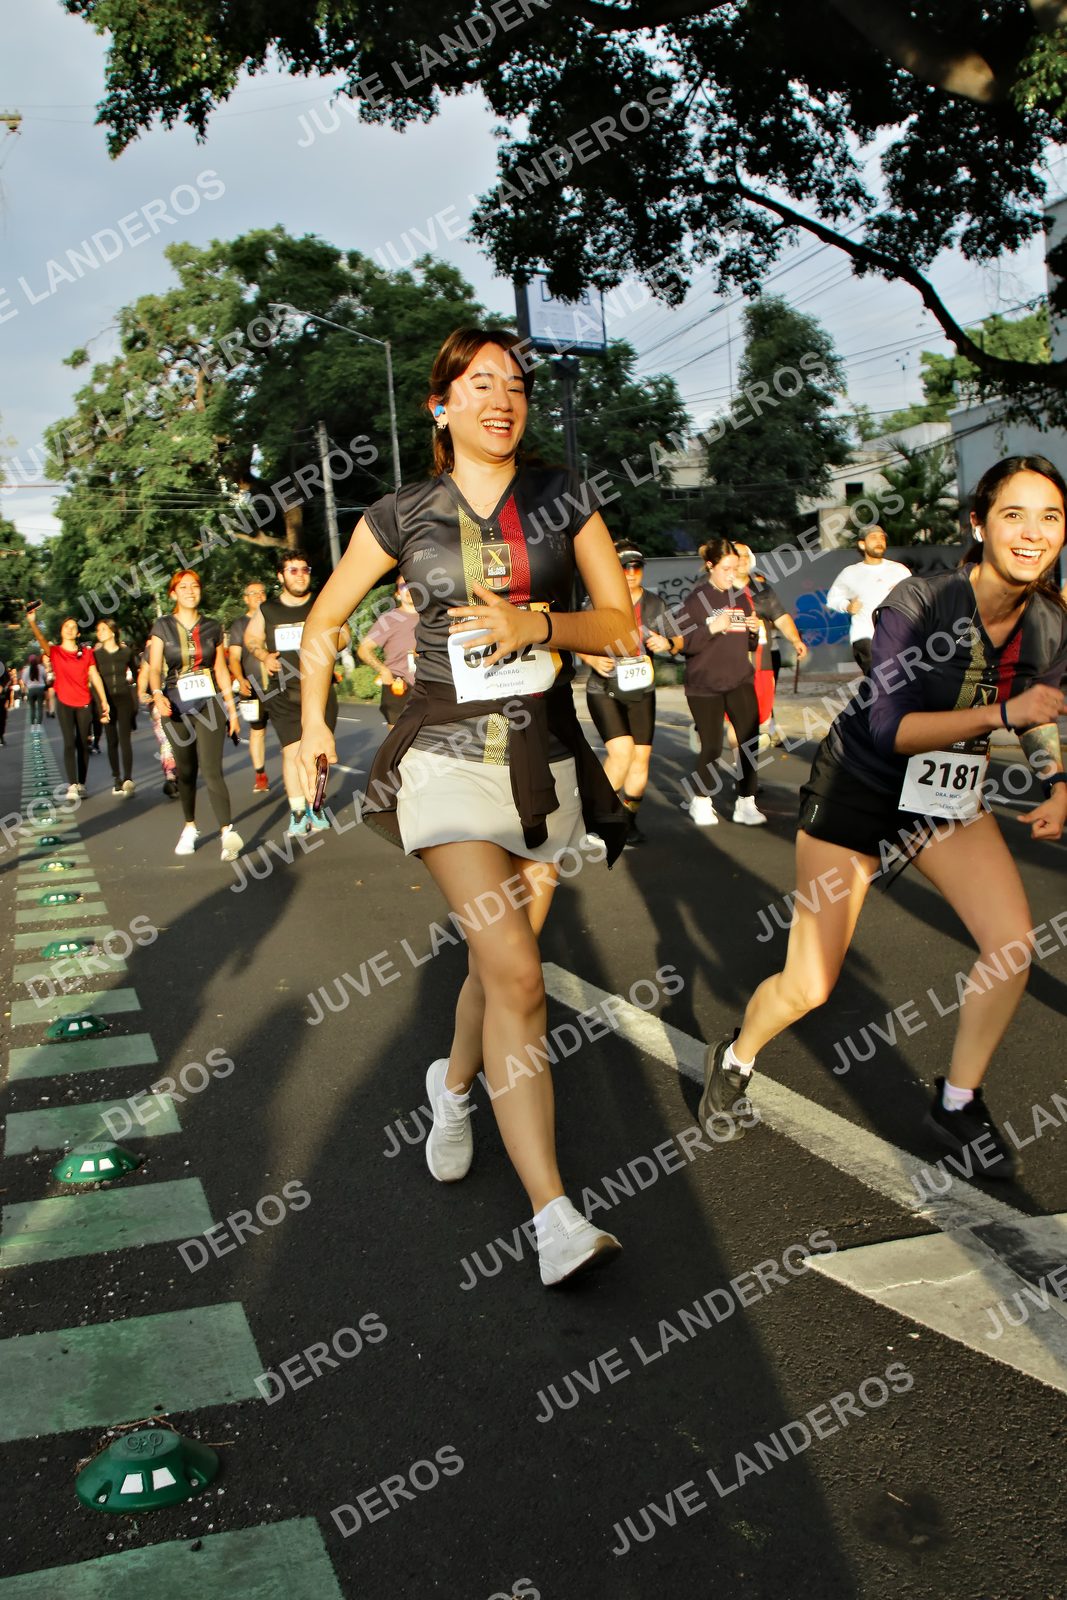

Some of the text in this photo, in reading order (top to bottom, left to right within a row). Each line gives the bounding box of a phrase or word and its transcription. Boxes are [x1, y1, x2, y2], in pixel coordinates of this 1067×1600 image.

[624, 666, 647, 680] 2976
[184, 678, 206, 690] 2718
[918, 759, 979, 790] 2181
